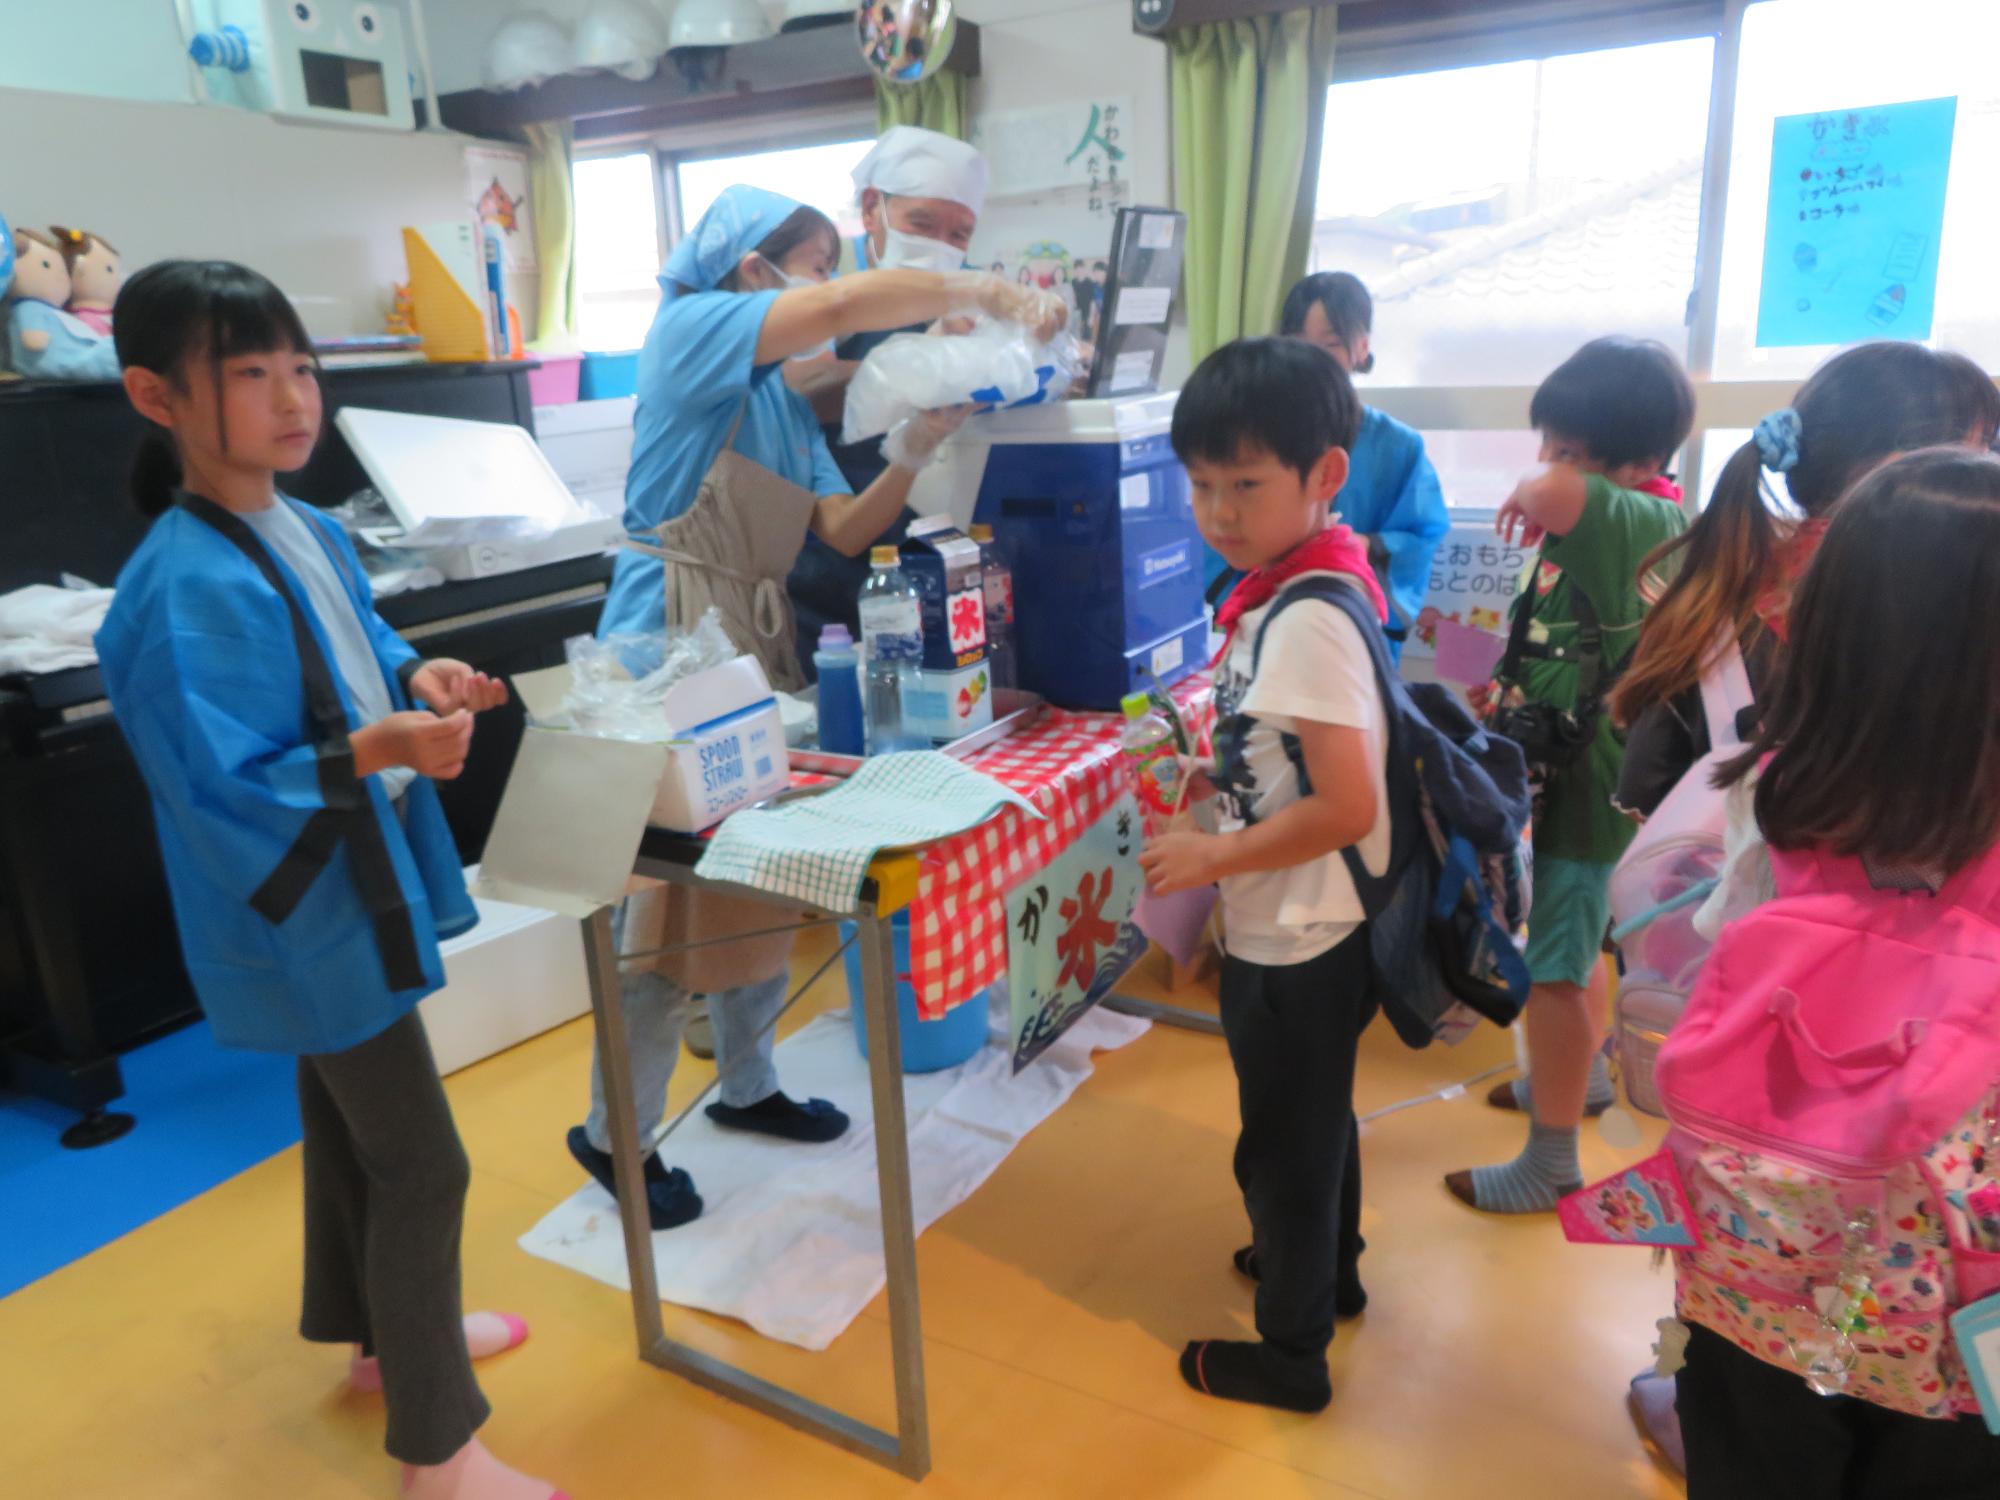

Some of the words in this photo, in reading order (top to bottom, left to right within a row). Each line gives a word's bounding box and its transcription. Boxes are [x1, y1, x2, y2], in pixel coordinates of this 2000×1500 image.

[1064, 103, 1125, 164] 人
[952, 596, 981, 641] 氷
[699, 734, 742, 769] SPOON
[703, 756, 745, 792] STRAW
[1055, 864, 1121, 993] 氷
